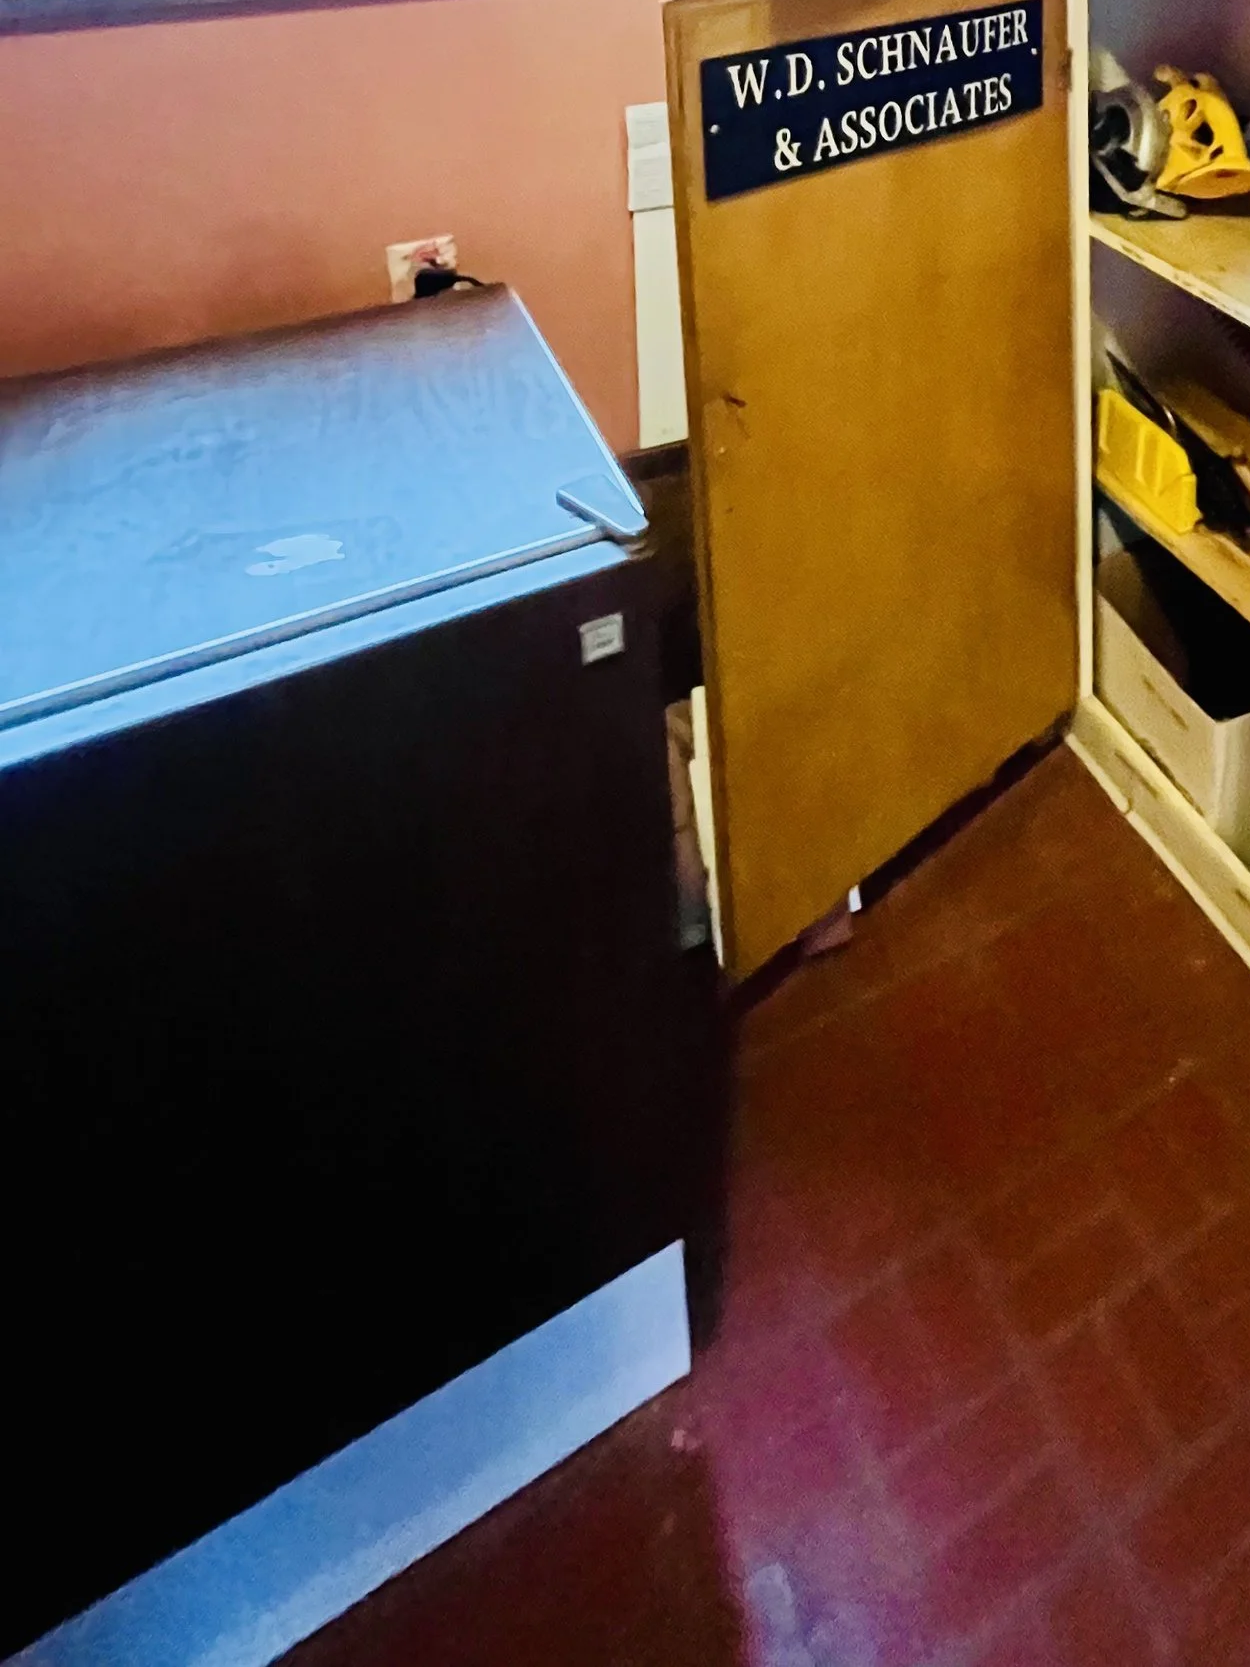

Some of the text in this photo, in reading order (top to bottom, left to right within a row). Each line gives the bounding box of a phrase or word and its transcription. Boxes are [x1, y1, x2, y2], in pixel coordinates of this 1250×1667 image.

[837, 8, 1029, 86] SCHNAUFER
[773, 72, 1013, 172] & ASSOCIATES
